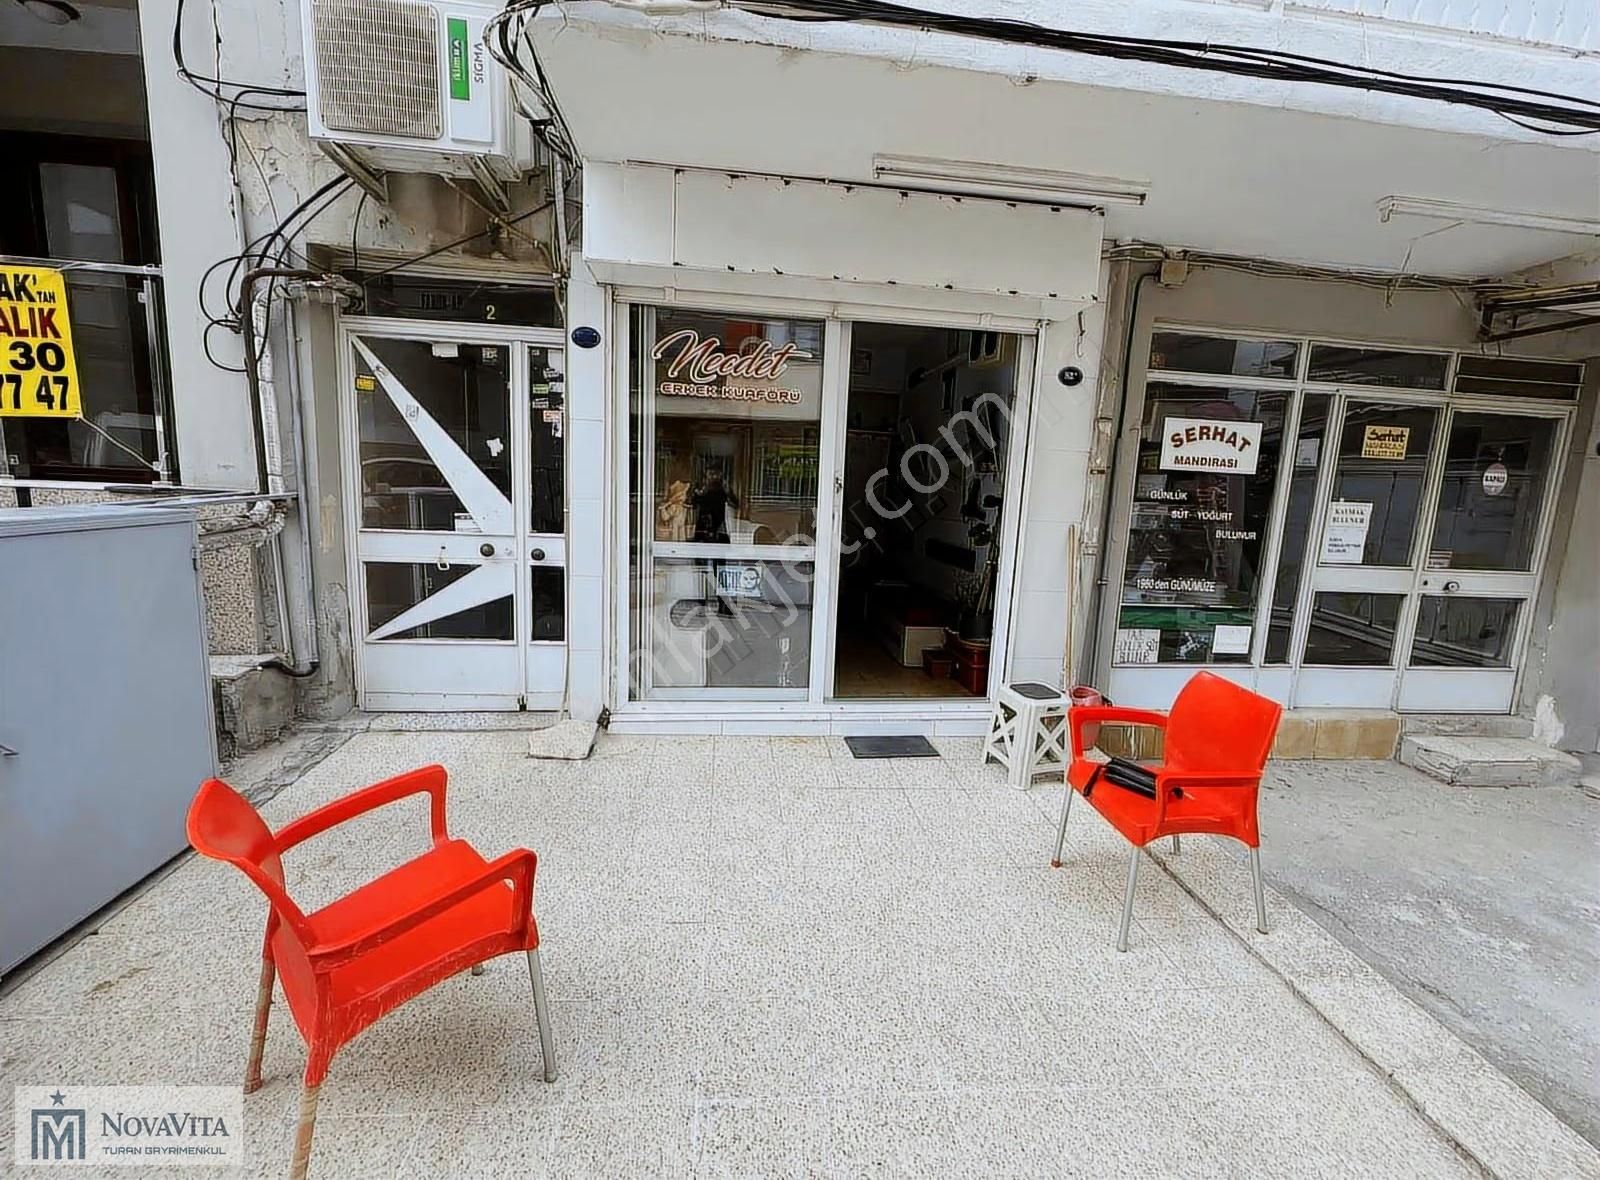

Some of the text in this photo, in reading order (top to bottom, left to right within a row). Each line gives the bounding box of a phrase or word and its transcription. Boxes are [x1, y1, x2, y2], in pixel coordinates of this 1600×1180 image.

[473, 42, 484, 84] SIGMA
[486, 306, 496, 320] 2
[9, 341, 66, 372] 30
[651, 329, 812, 384] Necdet
[36, 375, 69, 410] 47
[661, 382, 801, 403] ERKEK KUAFÖRÜ
[1170, 425, 1251, 452] SERHAT
[1174, 455, 1238, 468] MANDIRASI
[1150, 488, 1188, 500] GÜNLÜK
[1215, 529, 1257, 540] BULUNUR
